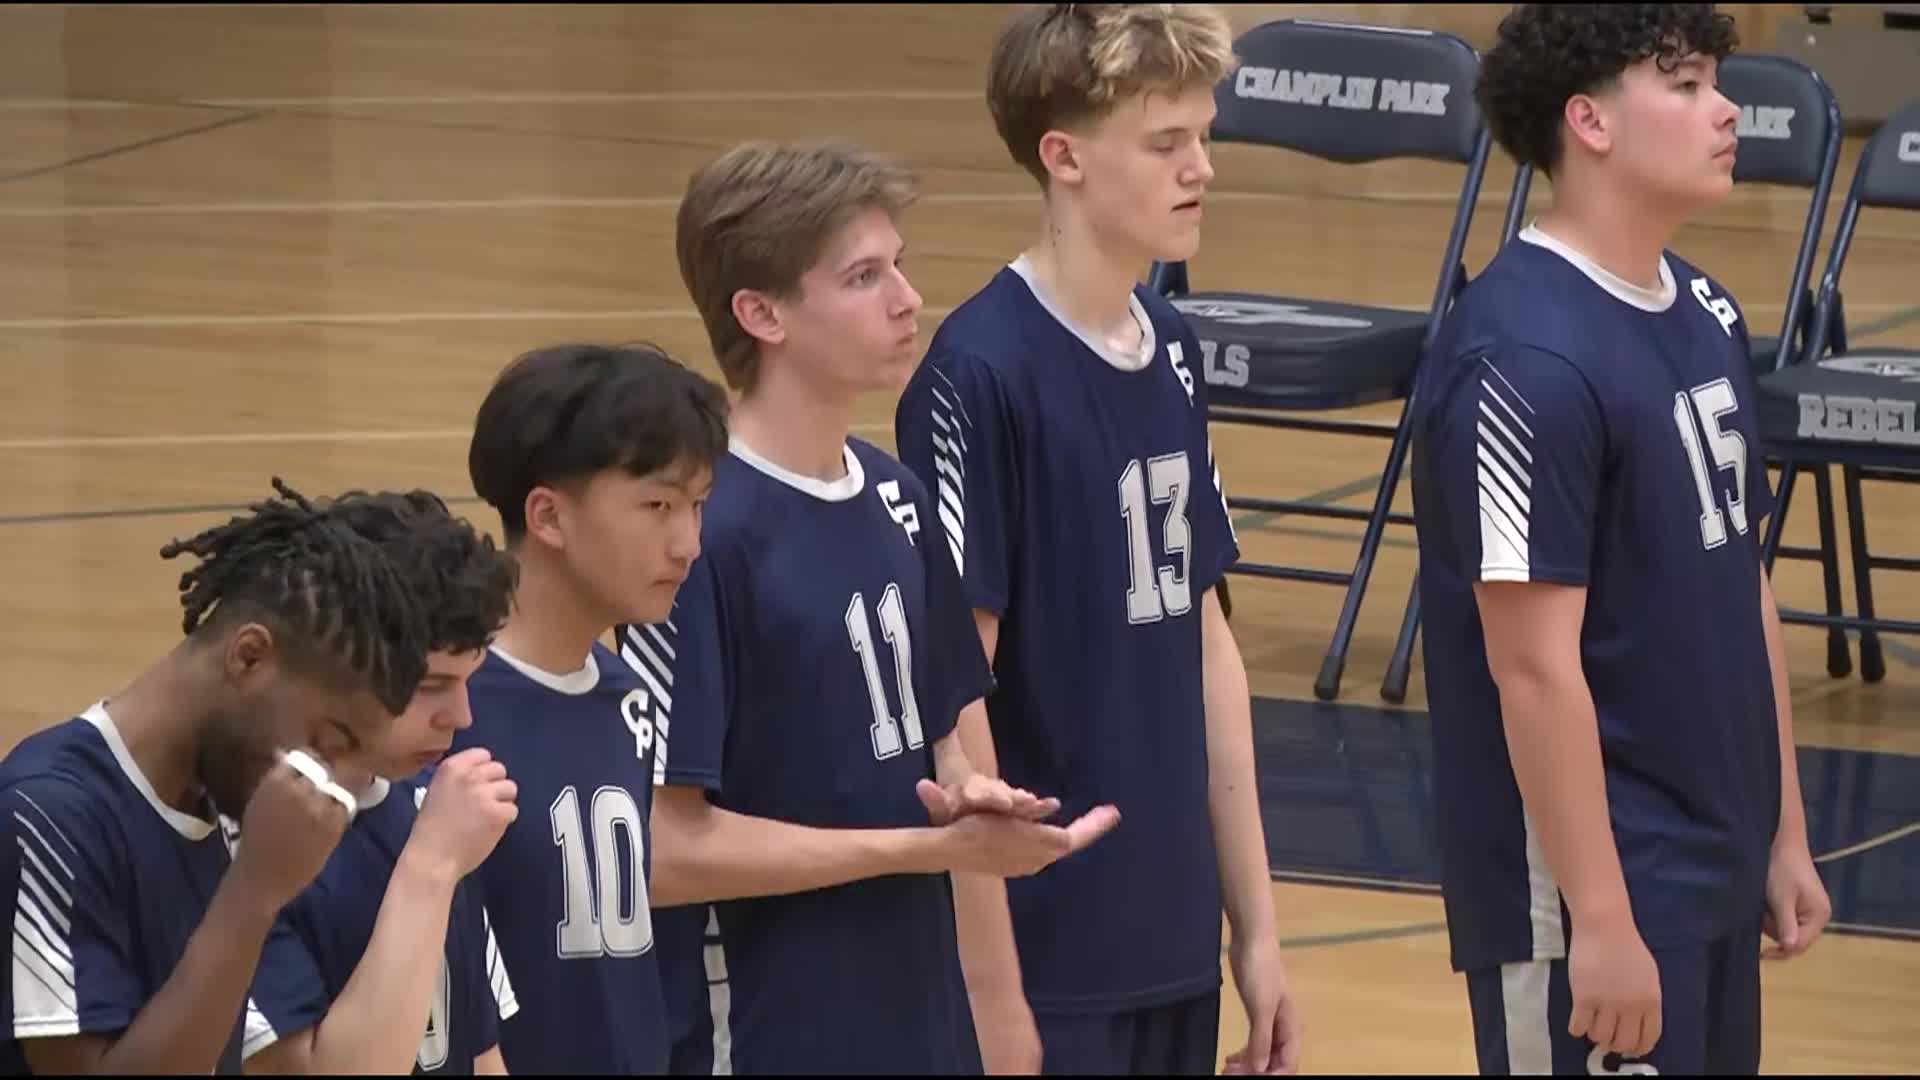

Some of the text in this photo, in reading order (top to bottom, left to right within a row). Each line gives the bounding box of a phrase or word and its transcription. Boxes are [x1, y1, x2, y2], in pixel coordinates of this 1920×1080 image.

[1235, 66, 1450, 116] CHAMPLIN PARK
[1735, 105, 1796, 139] ARK
[1673, 377, 1749, 551] 15
[1797, 393, 1920, 446] REBEL
[1118, 450, 1192, 624] 13
[845, 583, 925, 760] 11
[550, 785, 654, 959] 10
